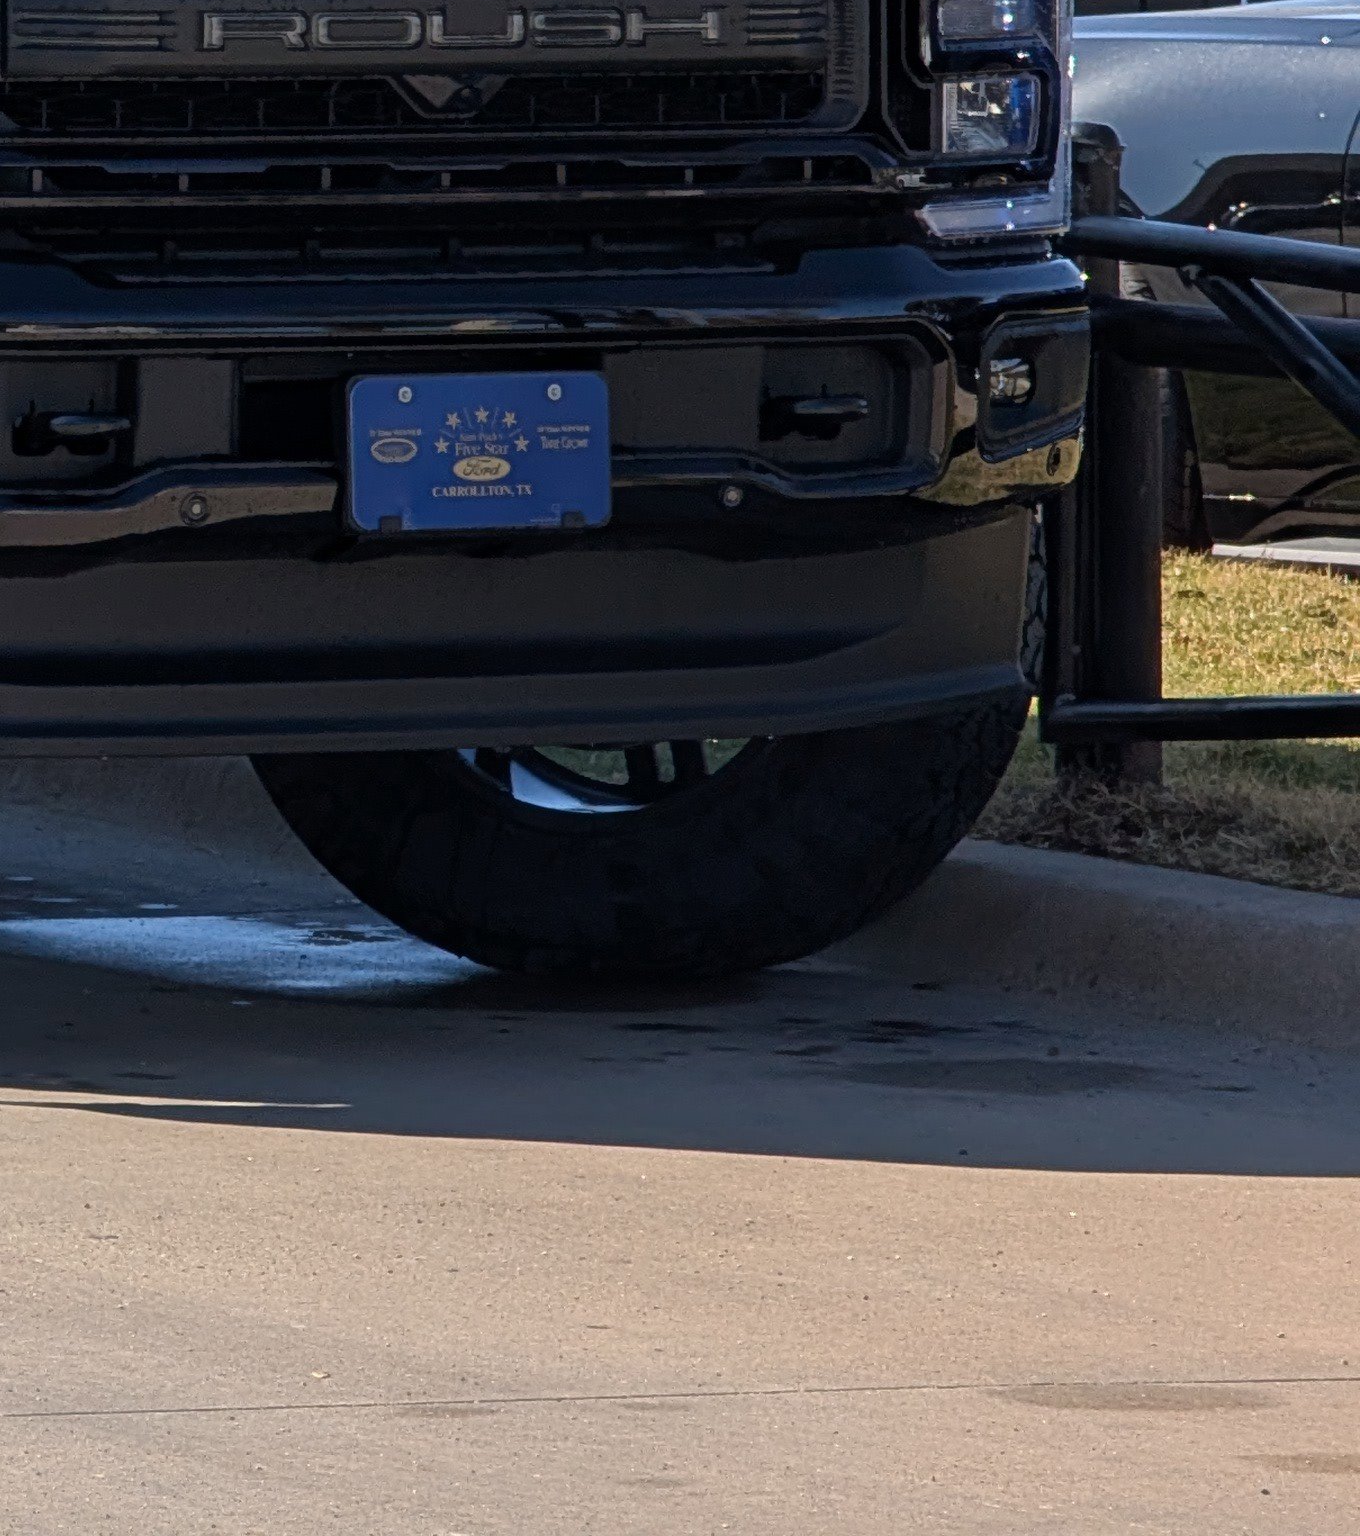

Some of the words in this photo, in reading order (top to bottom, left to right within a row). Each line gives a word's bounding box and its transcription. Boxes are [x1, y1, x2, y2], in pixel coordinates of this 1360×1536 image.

[200, 6, 721, 53] ROUSH
[454, 442, 482, 456] Five
[484, 443, 510, 456] Star
[462, 458, 502, 477] Ford
